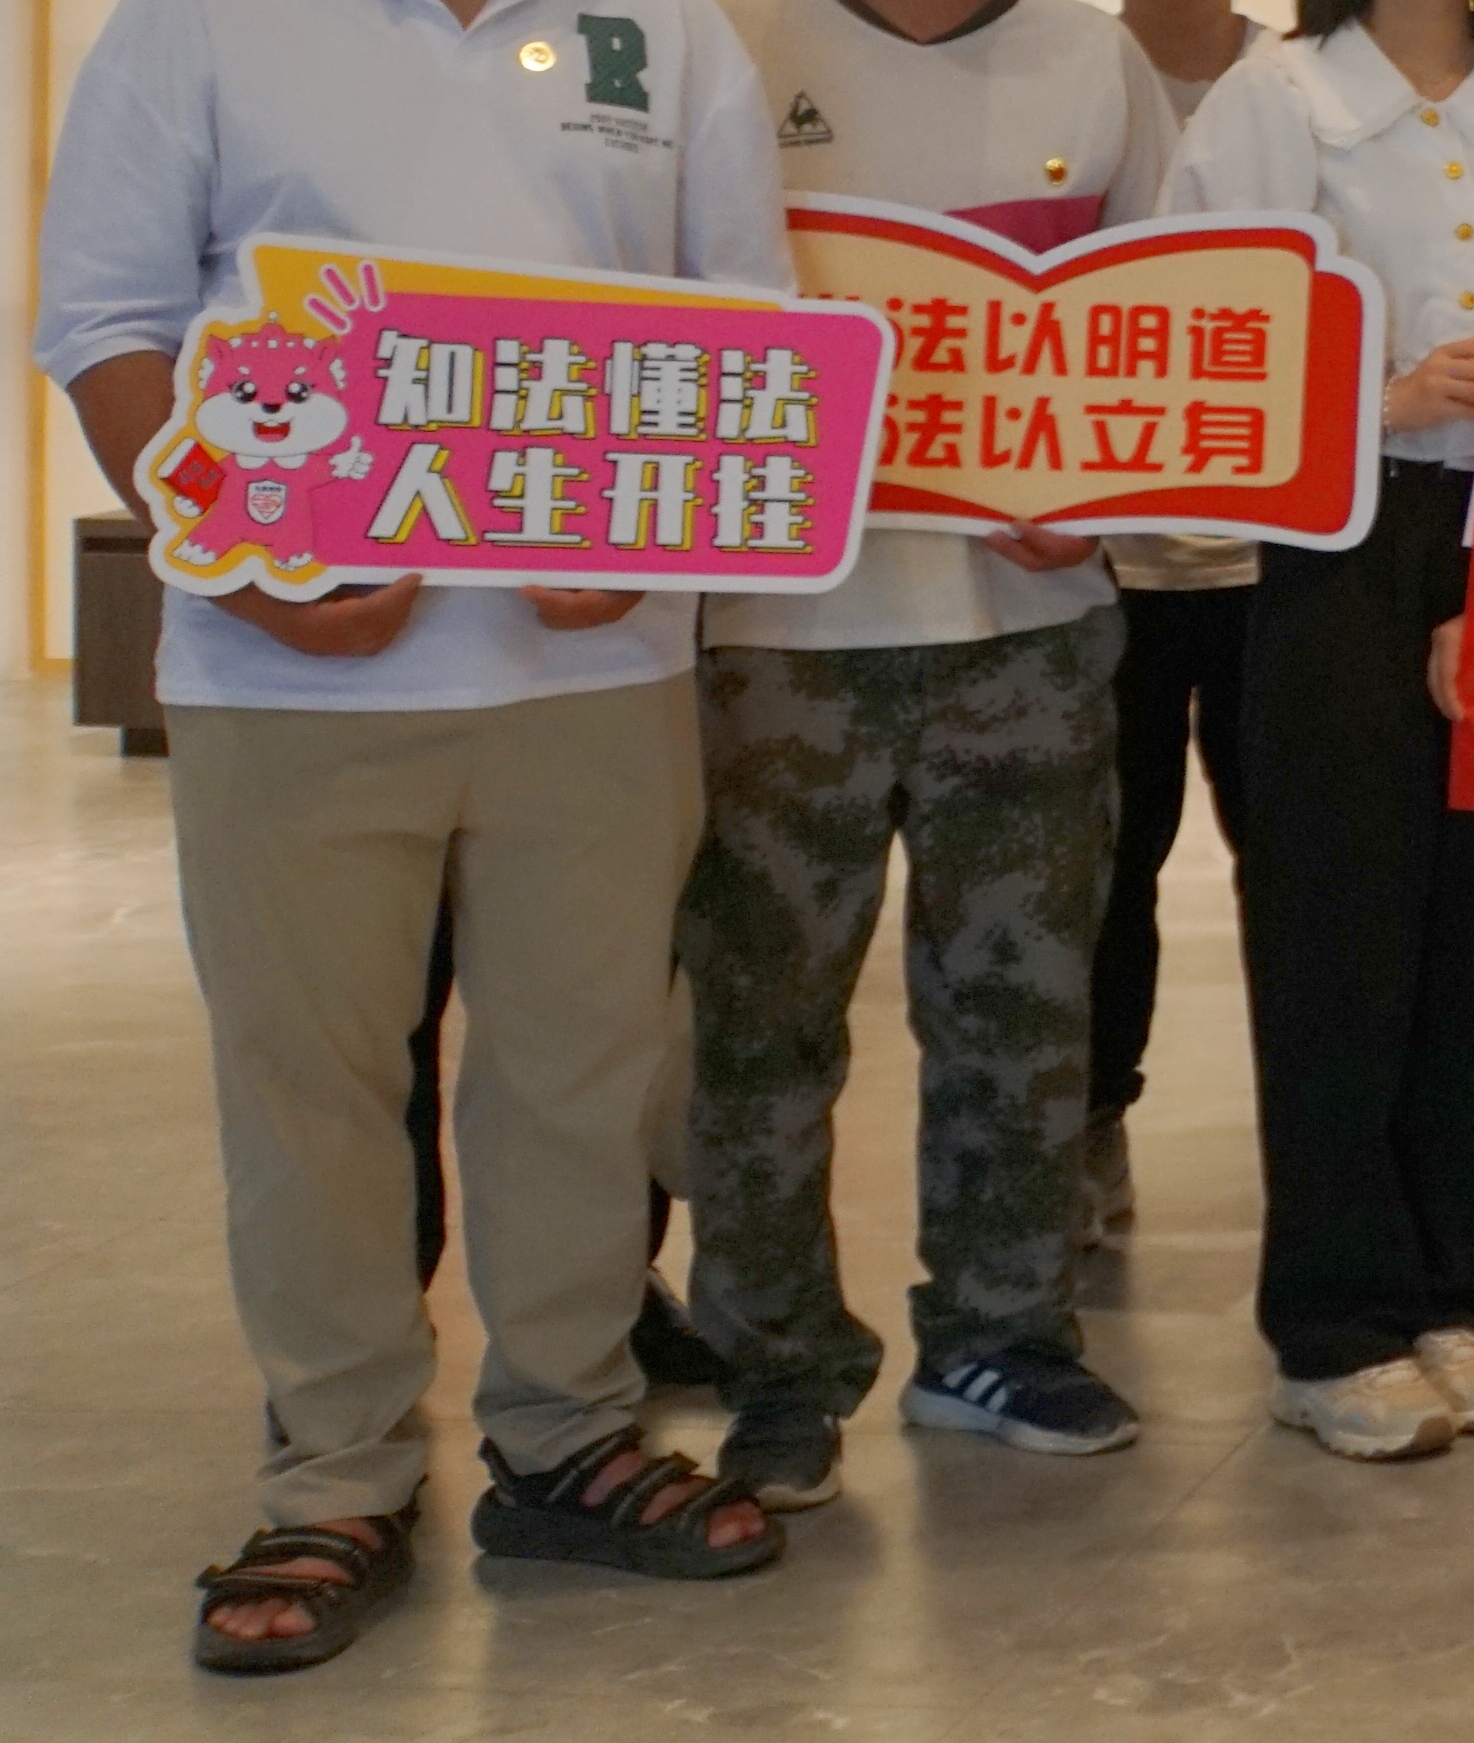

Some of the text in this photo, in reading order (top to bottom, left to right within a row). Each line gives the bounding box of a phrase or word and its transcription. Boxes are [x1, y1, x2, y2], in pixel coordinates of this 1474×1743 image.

[577, 12, 650, 113] R
[373, 327, 820, 447] 知法懂法
[797, 293, 1271, 383] 法以明道
[365, 442, 816, 556] 人生开挂
